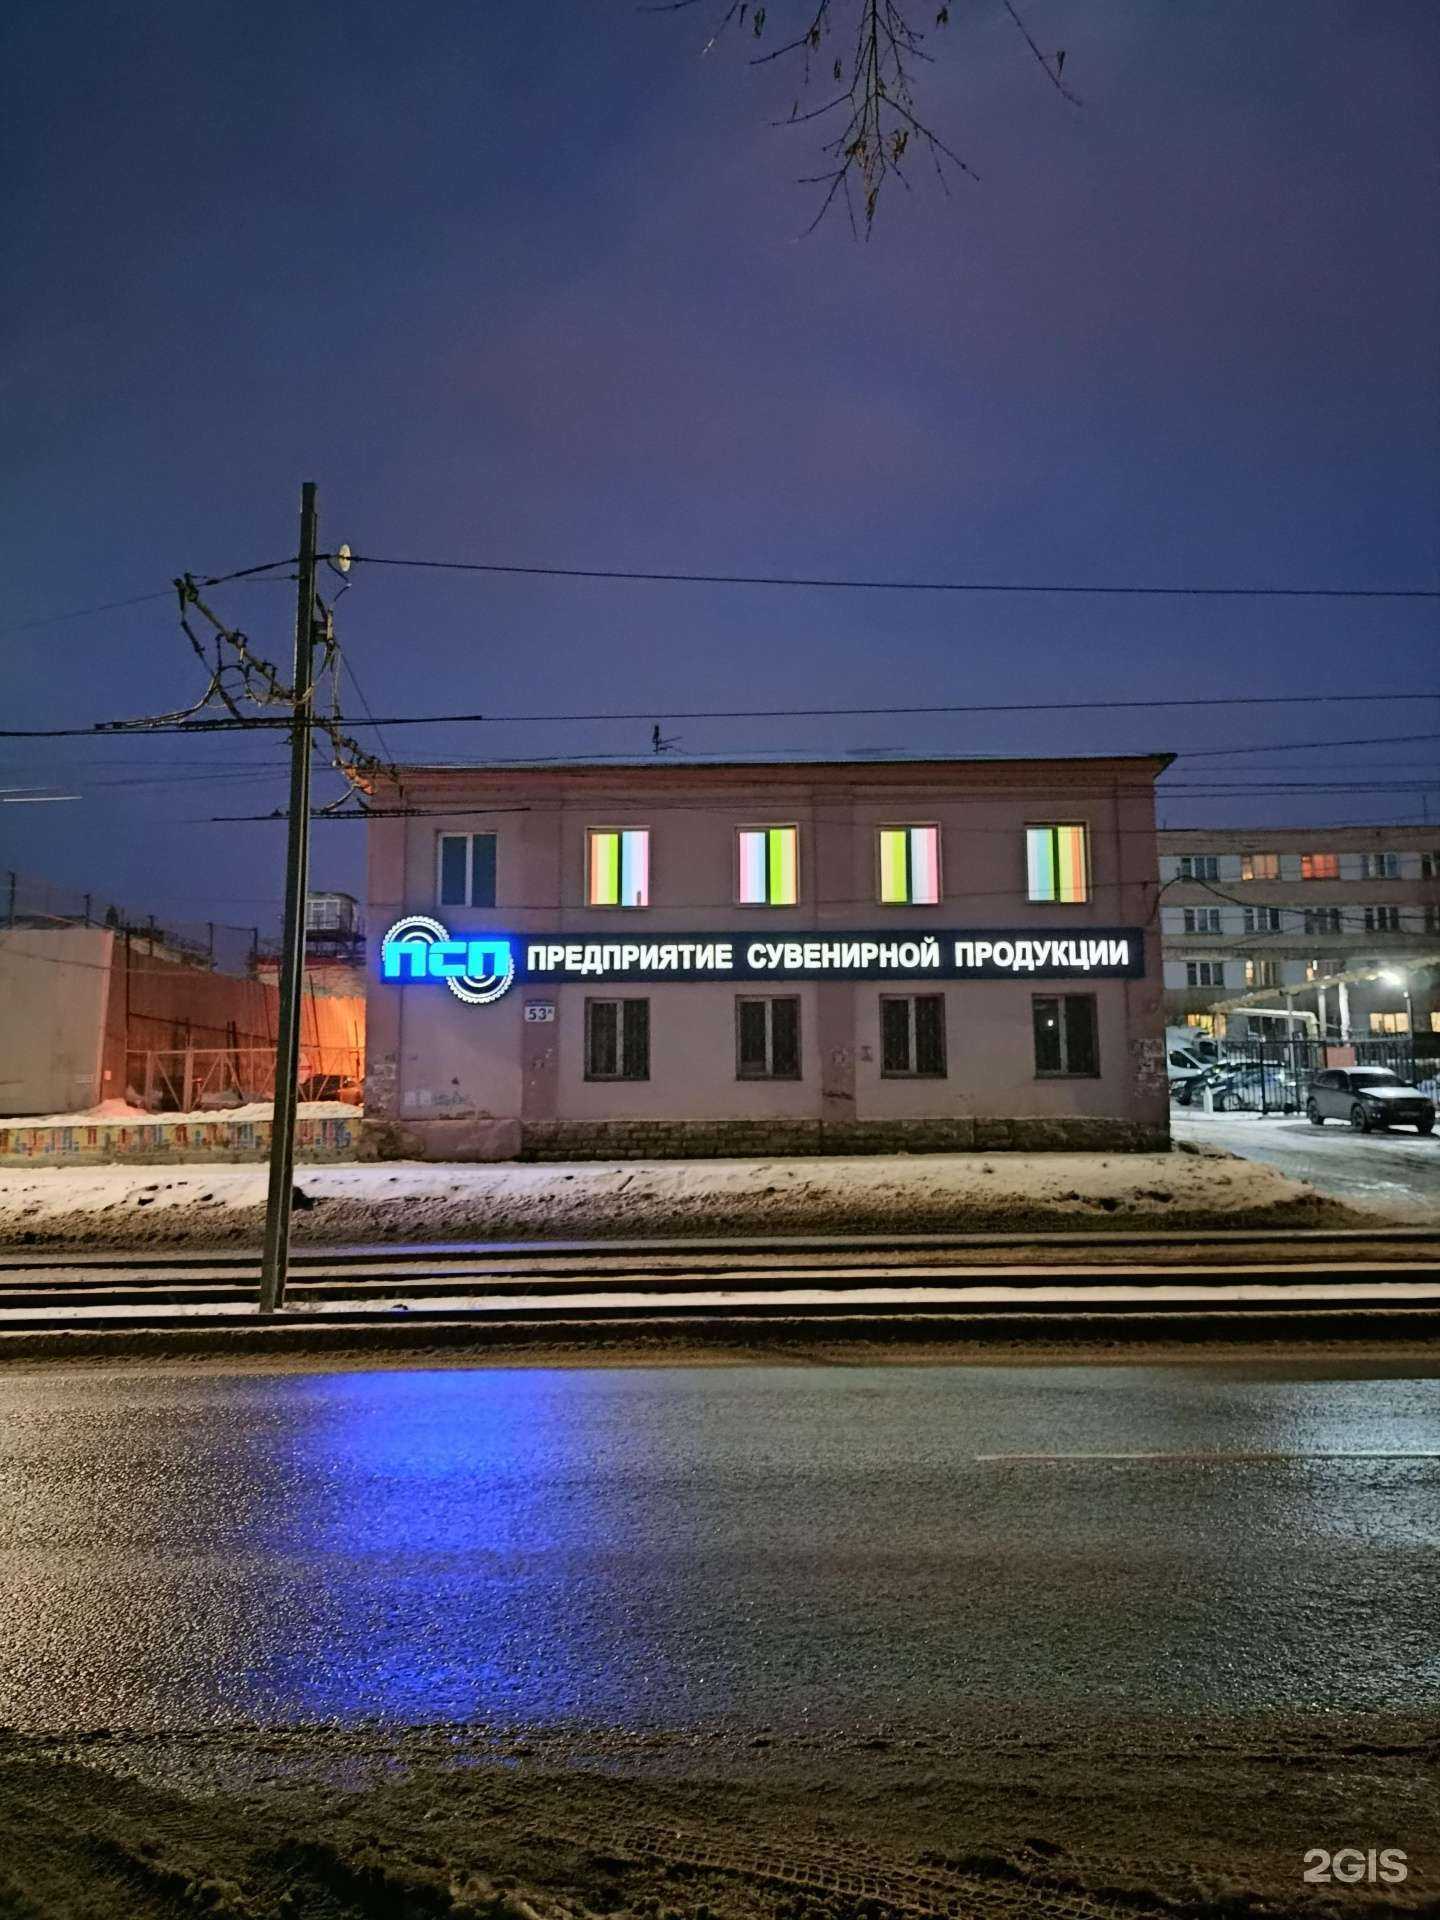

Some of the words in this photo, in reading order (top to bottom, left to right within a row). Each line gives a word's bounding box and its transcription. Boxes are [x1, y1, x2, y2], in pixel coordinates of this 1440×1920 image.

[527, 943, 733, 975] ПРЕДПРИЯТИЕ
[747, 936, 940, 970] СУВЕНИРНОЙ
[954, 940, 1130, 971] ПРОДУКЦИИ
